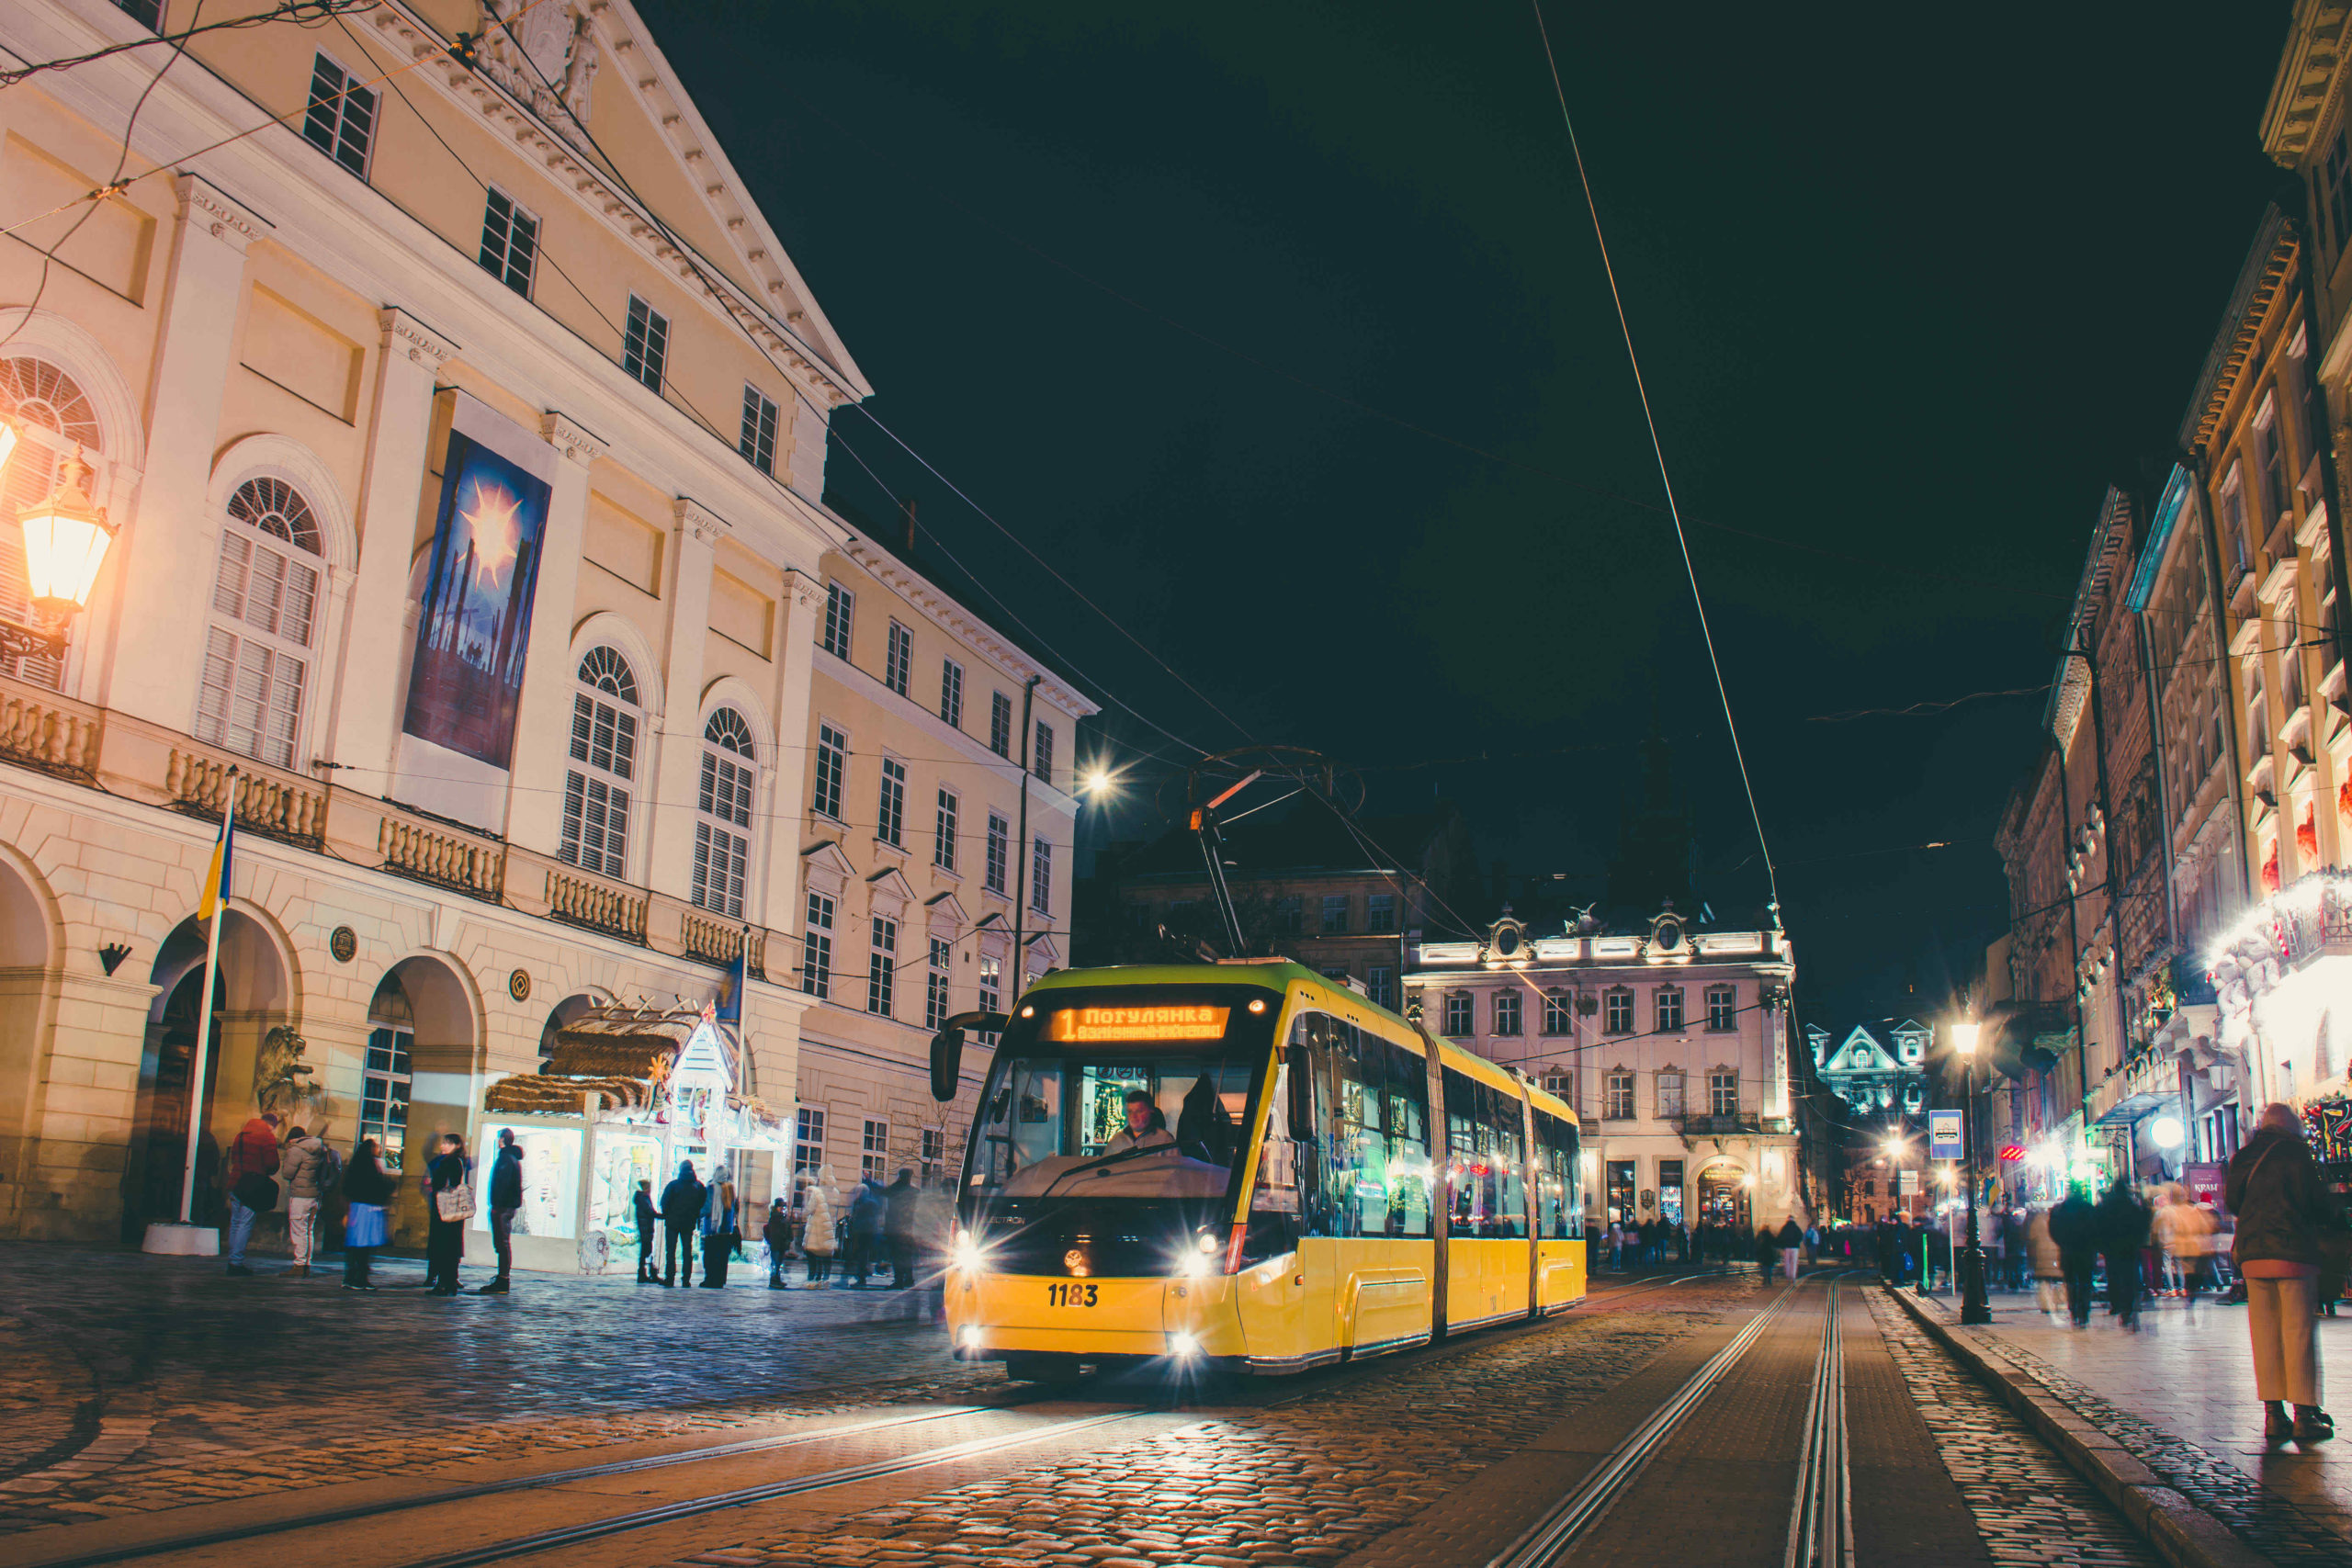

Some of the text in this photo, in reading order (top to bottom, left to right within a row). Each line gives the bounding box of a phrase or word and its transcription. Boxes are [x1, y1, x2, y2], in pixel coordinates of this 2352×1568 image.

[1062, 1010, 1076, 1040] 1
[1085, 1009, 1213, 1023] Погулянка
[1048, 1283, 1099, 1307] 1183
